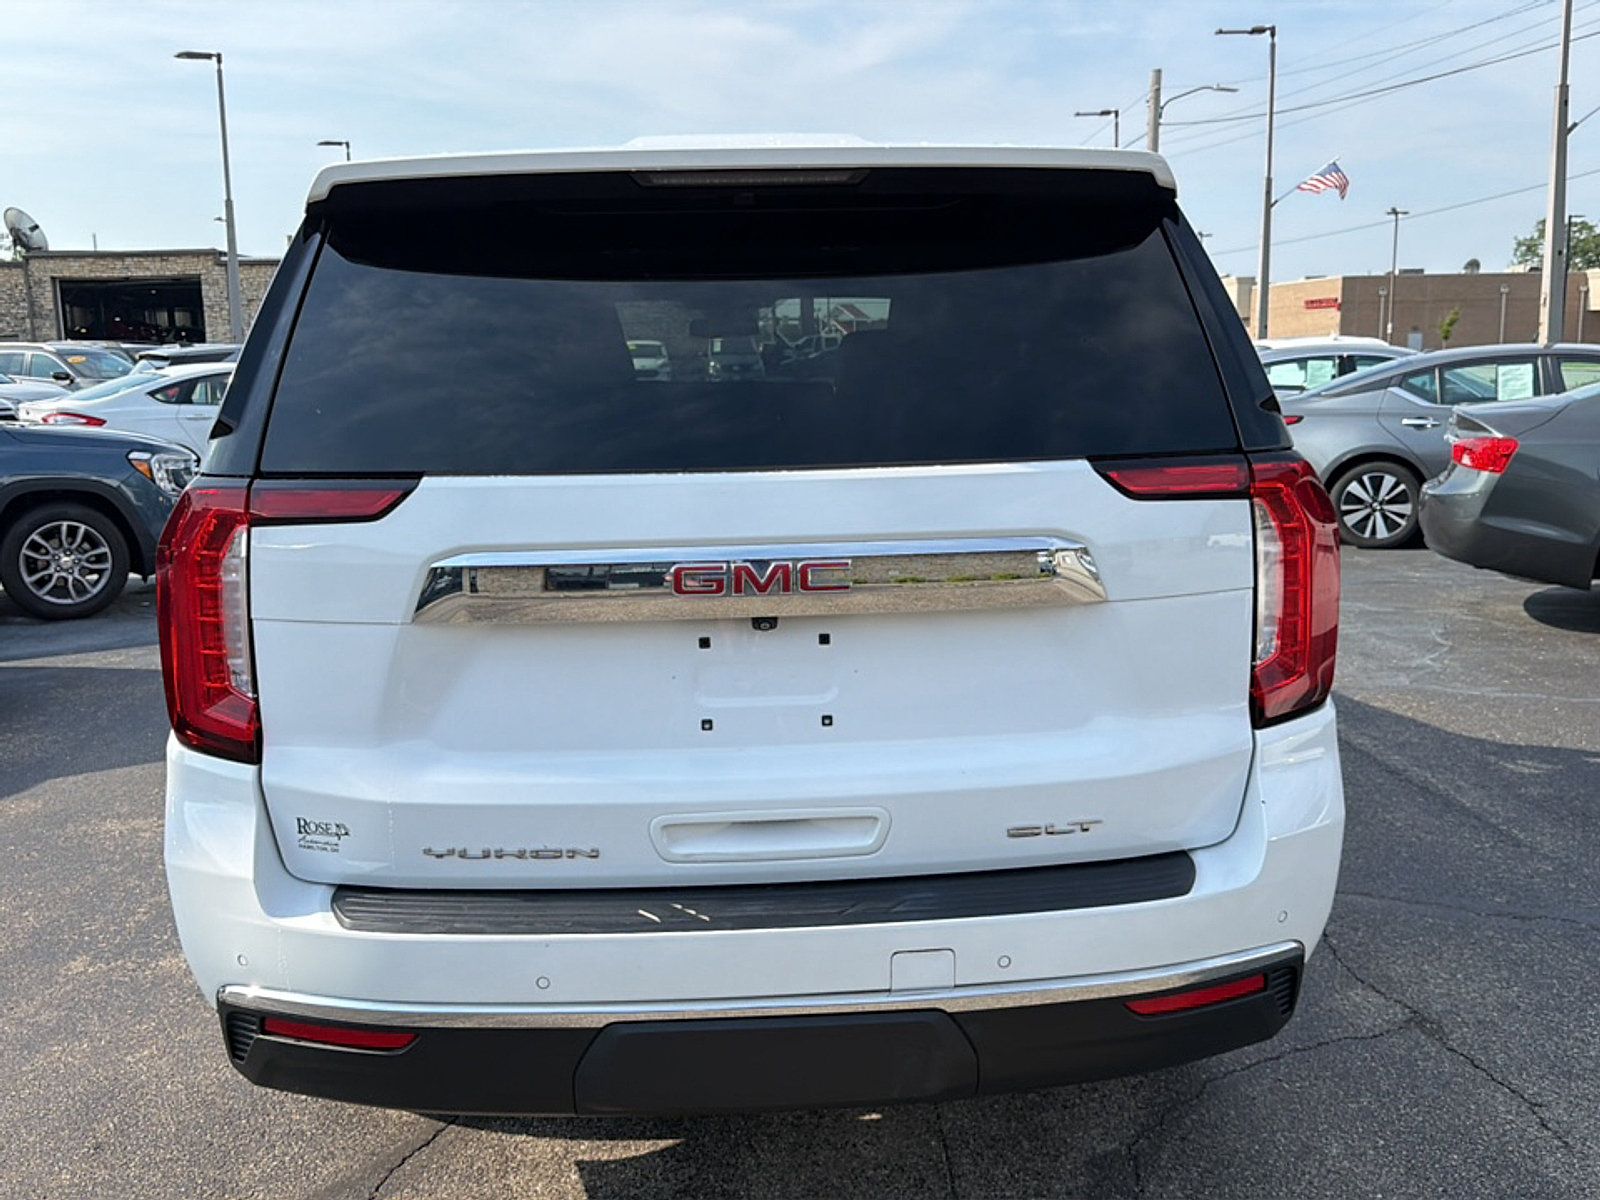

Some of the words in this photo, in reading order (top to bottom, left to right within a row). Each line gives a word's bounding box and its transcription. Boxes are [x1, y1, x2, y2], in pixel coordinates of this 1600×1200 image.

[672, 559, 852, 597] GMC
[1007, 820, 1103, 838] SLT
[423, 848, 600, 859] YUKON
